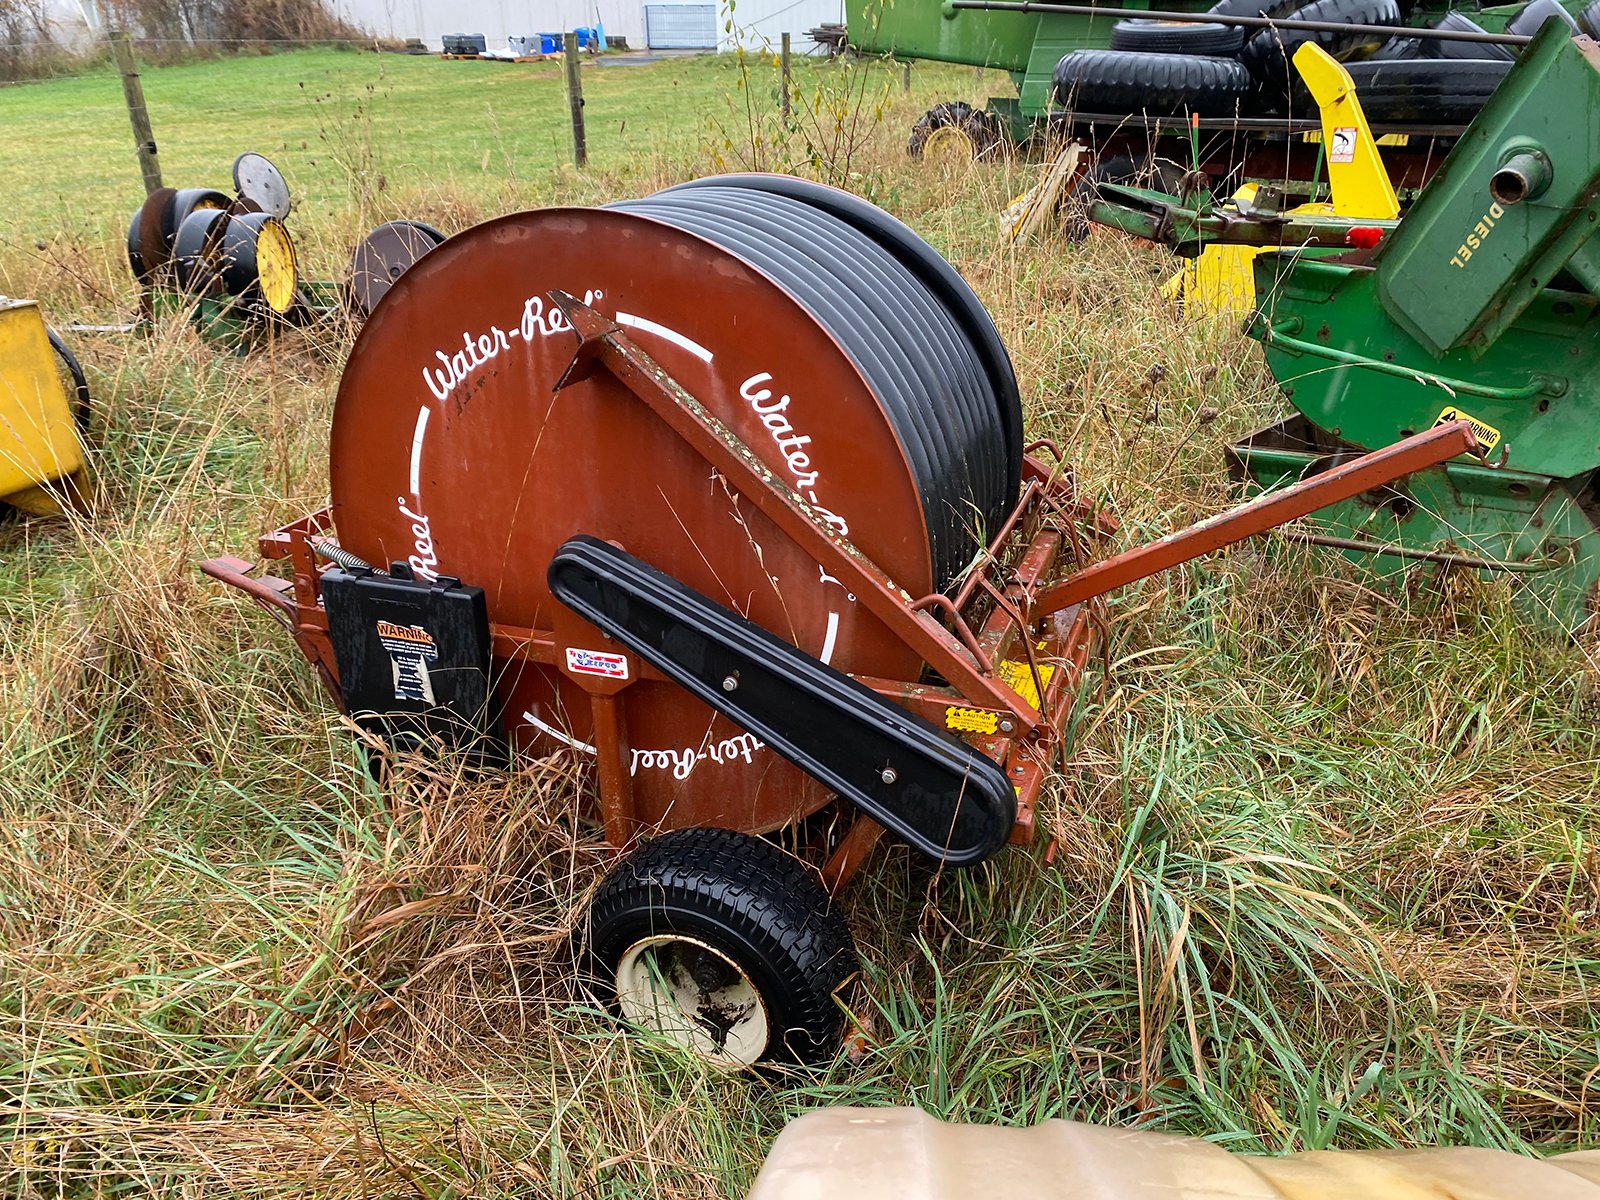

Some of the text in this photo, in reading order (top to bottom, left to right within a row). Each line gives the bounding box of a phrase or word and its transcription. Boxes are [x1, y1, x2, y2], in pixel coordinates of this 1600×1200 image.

[1448, 201, 1505, 268] DIESEL
[422, 289, 593, 400] Water-Rel
[1468, 419, 1498, 444] ARNING
[962, 712, 991, 721] CAUTION
[630, 732, 765, 780] ater-Reel
